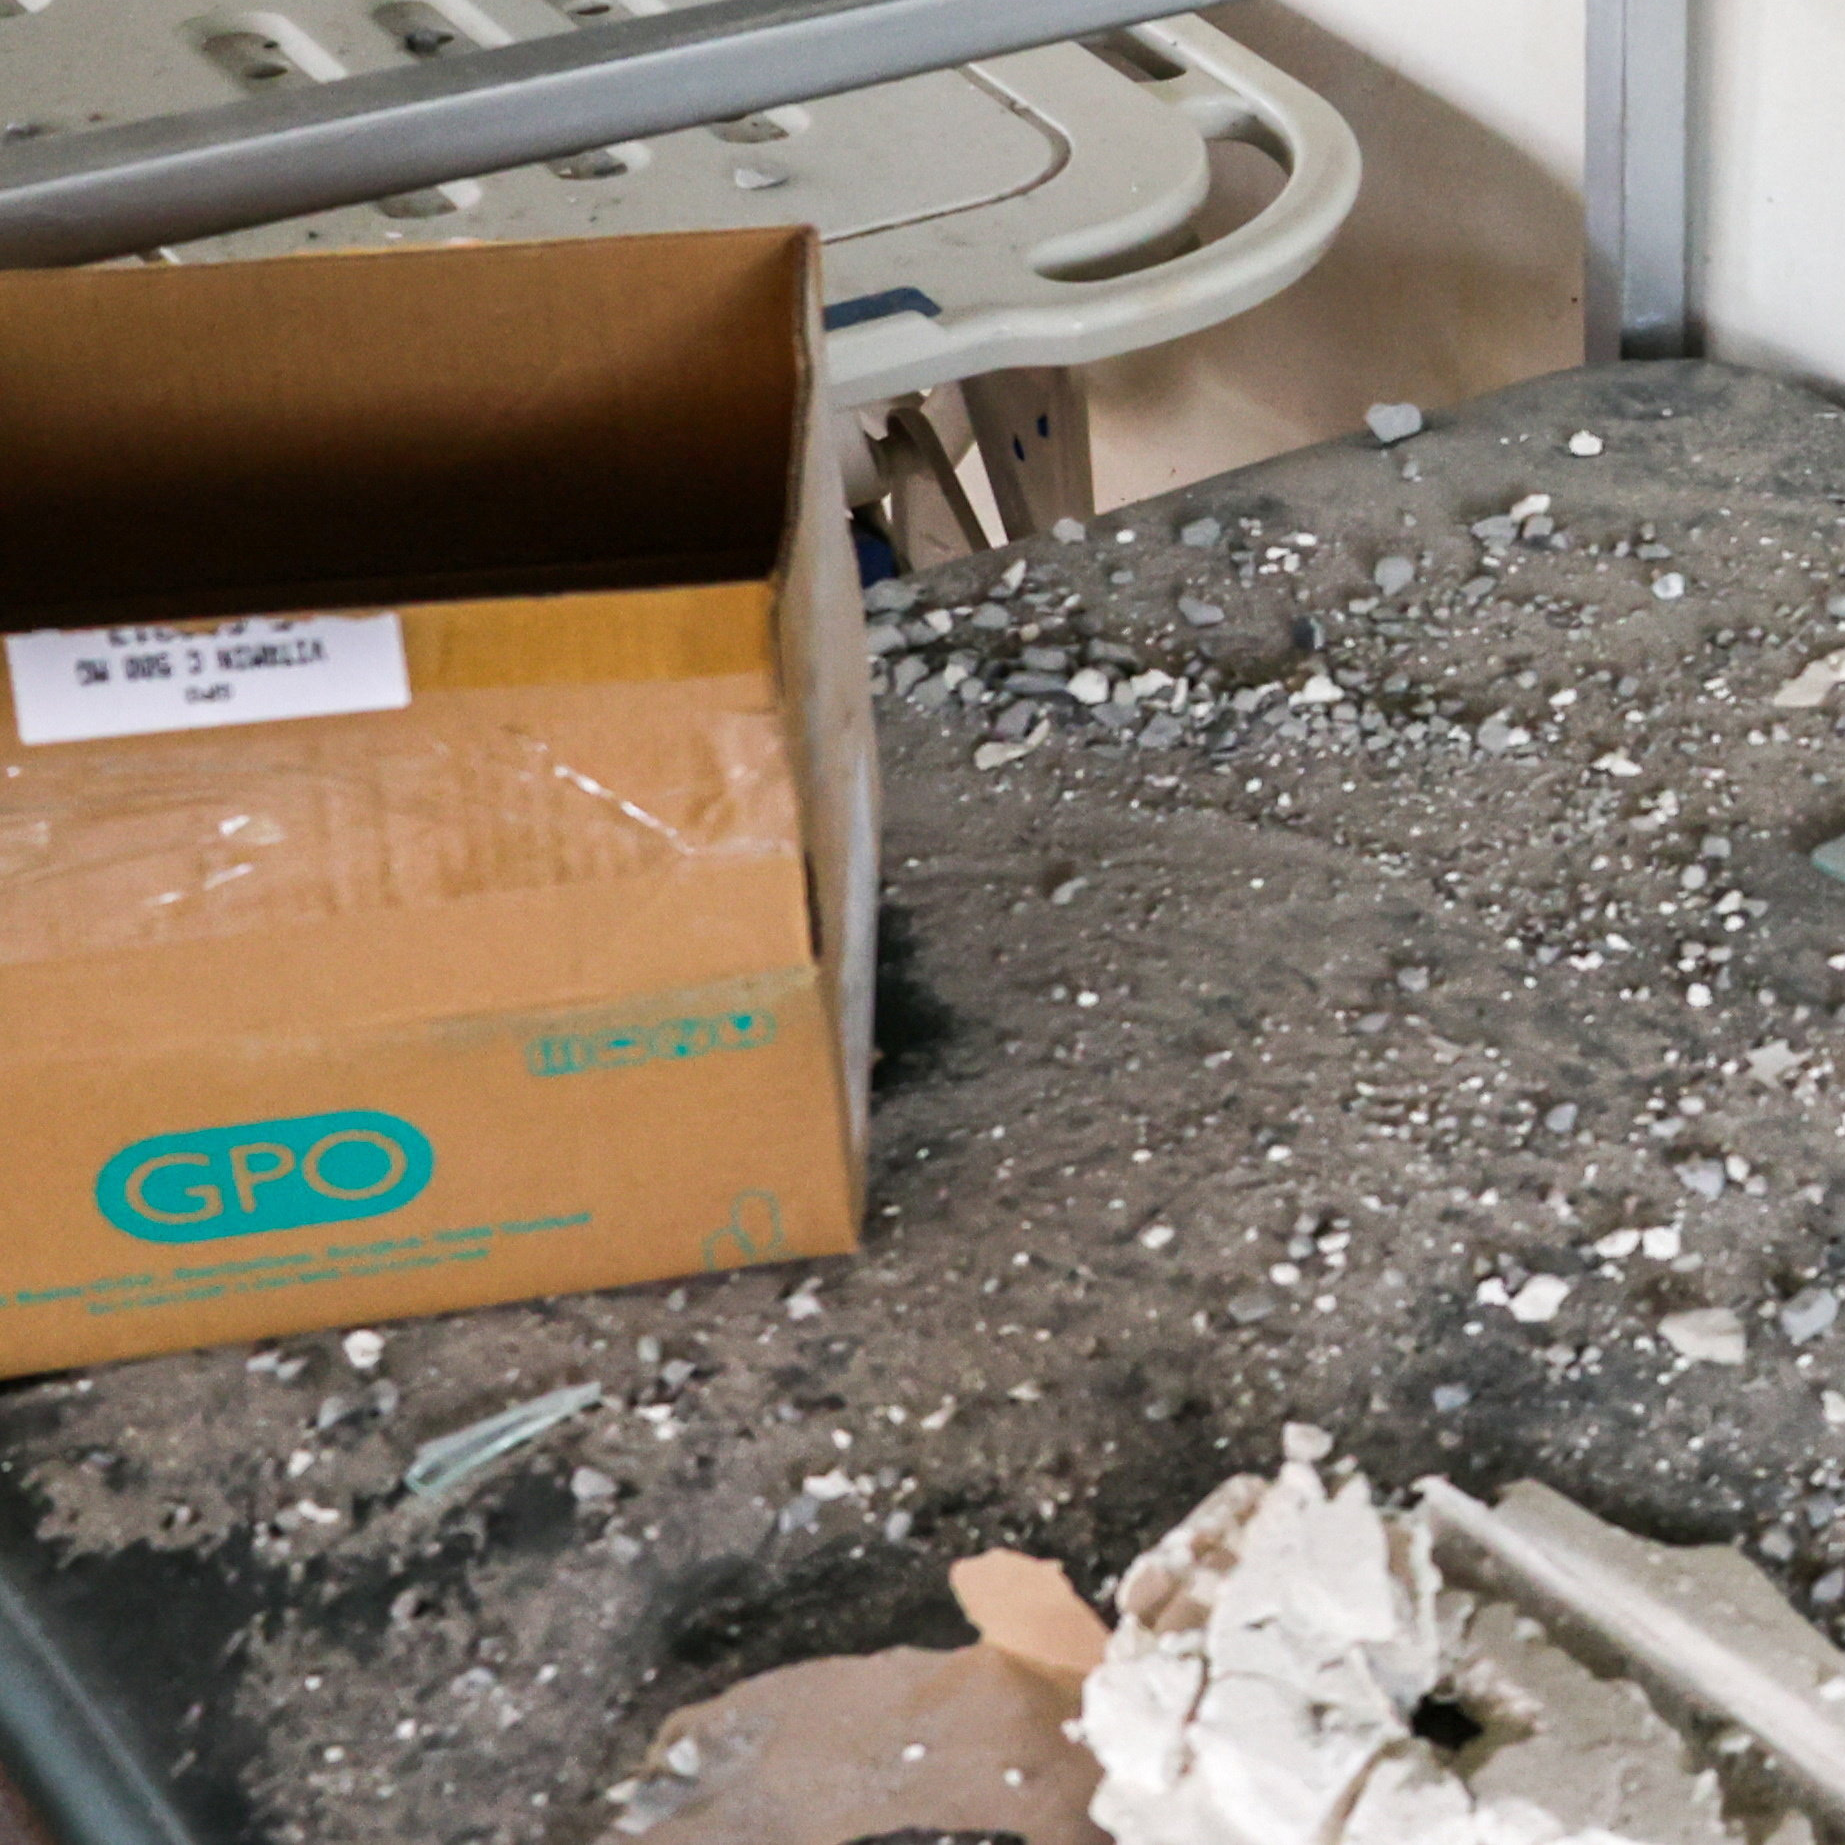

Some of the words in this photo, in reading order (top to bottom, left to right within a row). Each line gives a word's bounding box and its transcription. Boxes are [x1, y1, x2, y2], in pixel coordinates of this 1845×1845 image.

[187, 648, 205, 675] C
[217, 638, 328, 672] VITAMIN
[125, 1128, 409, 1225] GPO
